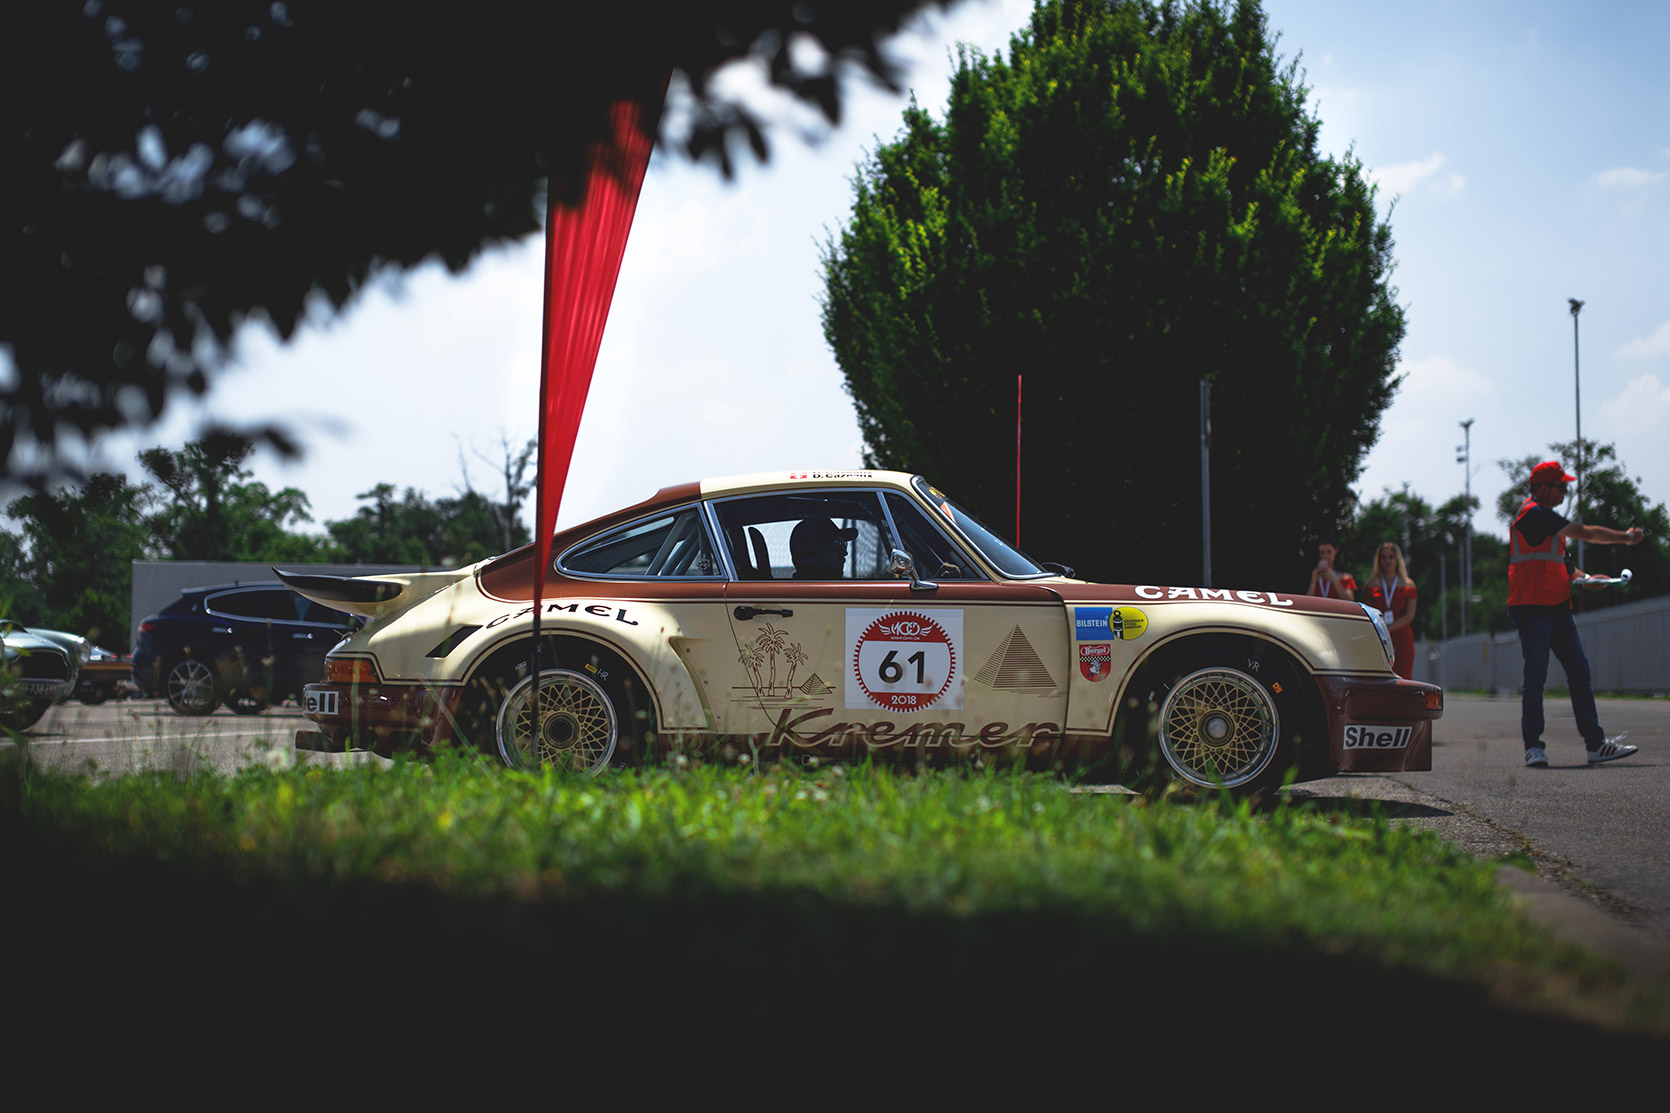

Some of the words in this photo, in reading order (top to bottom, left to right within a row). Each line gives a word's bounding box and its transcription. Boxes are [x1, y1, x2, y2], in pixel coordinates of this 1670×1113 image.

[1135, 585, 1293, 606] CAMEL
[486, 603, 639, 629] CAMEL
[1076, 619, 1108, 628] BILSTEIN
[879, 650, 925, 684] 61
[303, 693, 336, 712] ell
[891, 695, 917, 705] 2018
[766, 707, 1061, 748] Kremer
[1345, 726, 1411, 748] Shell
